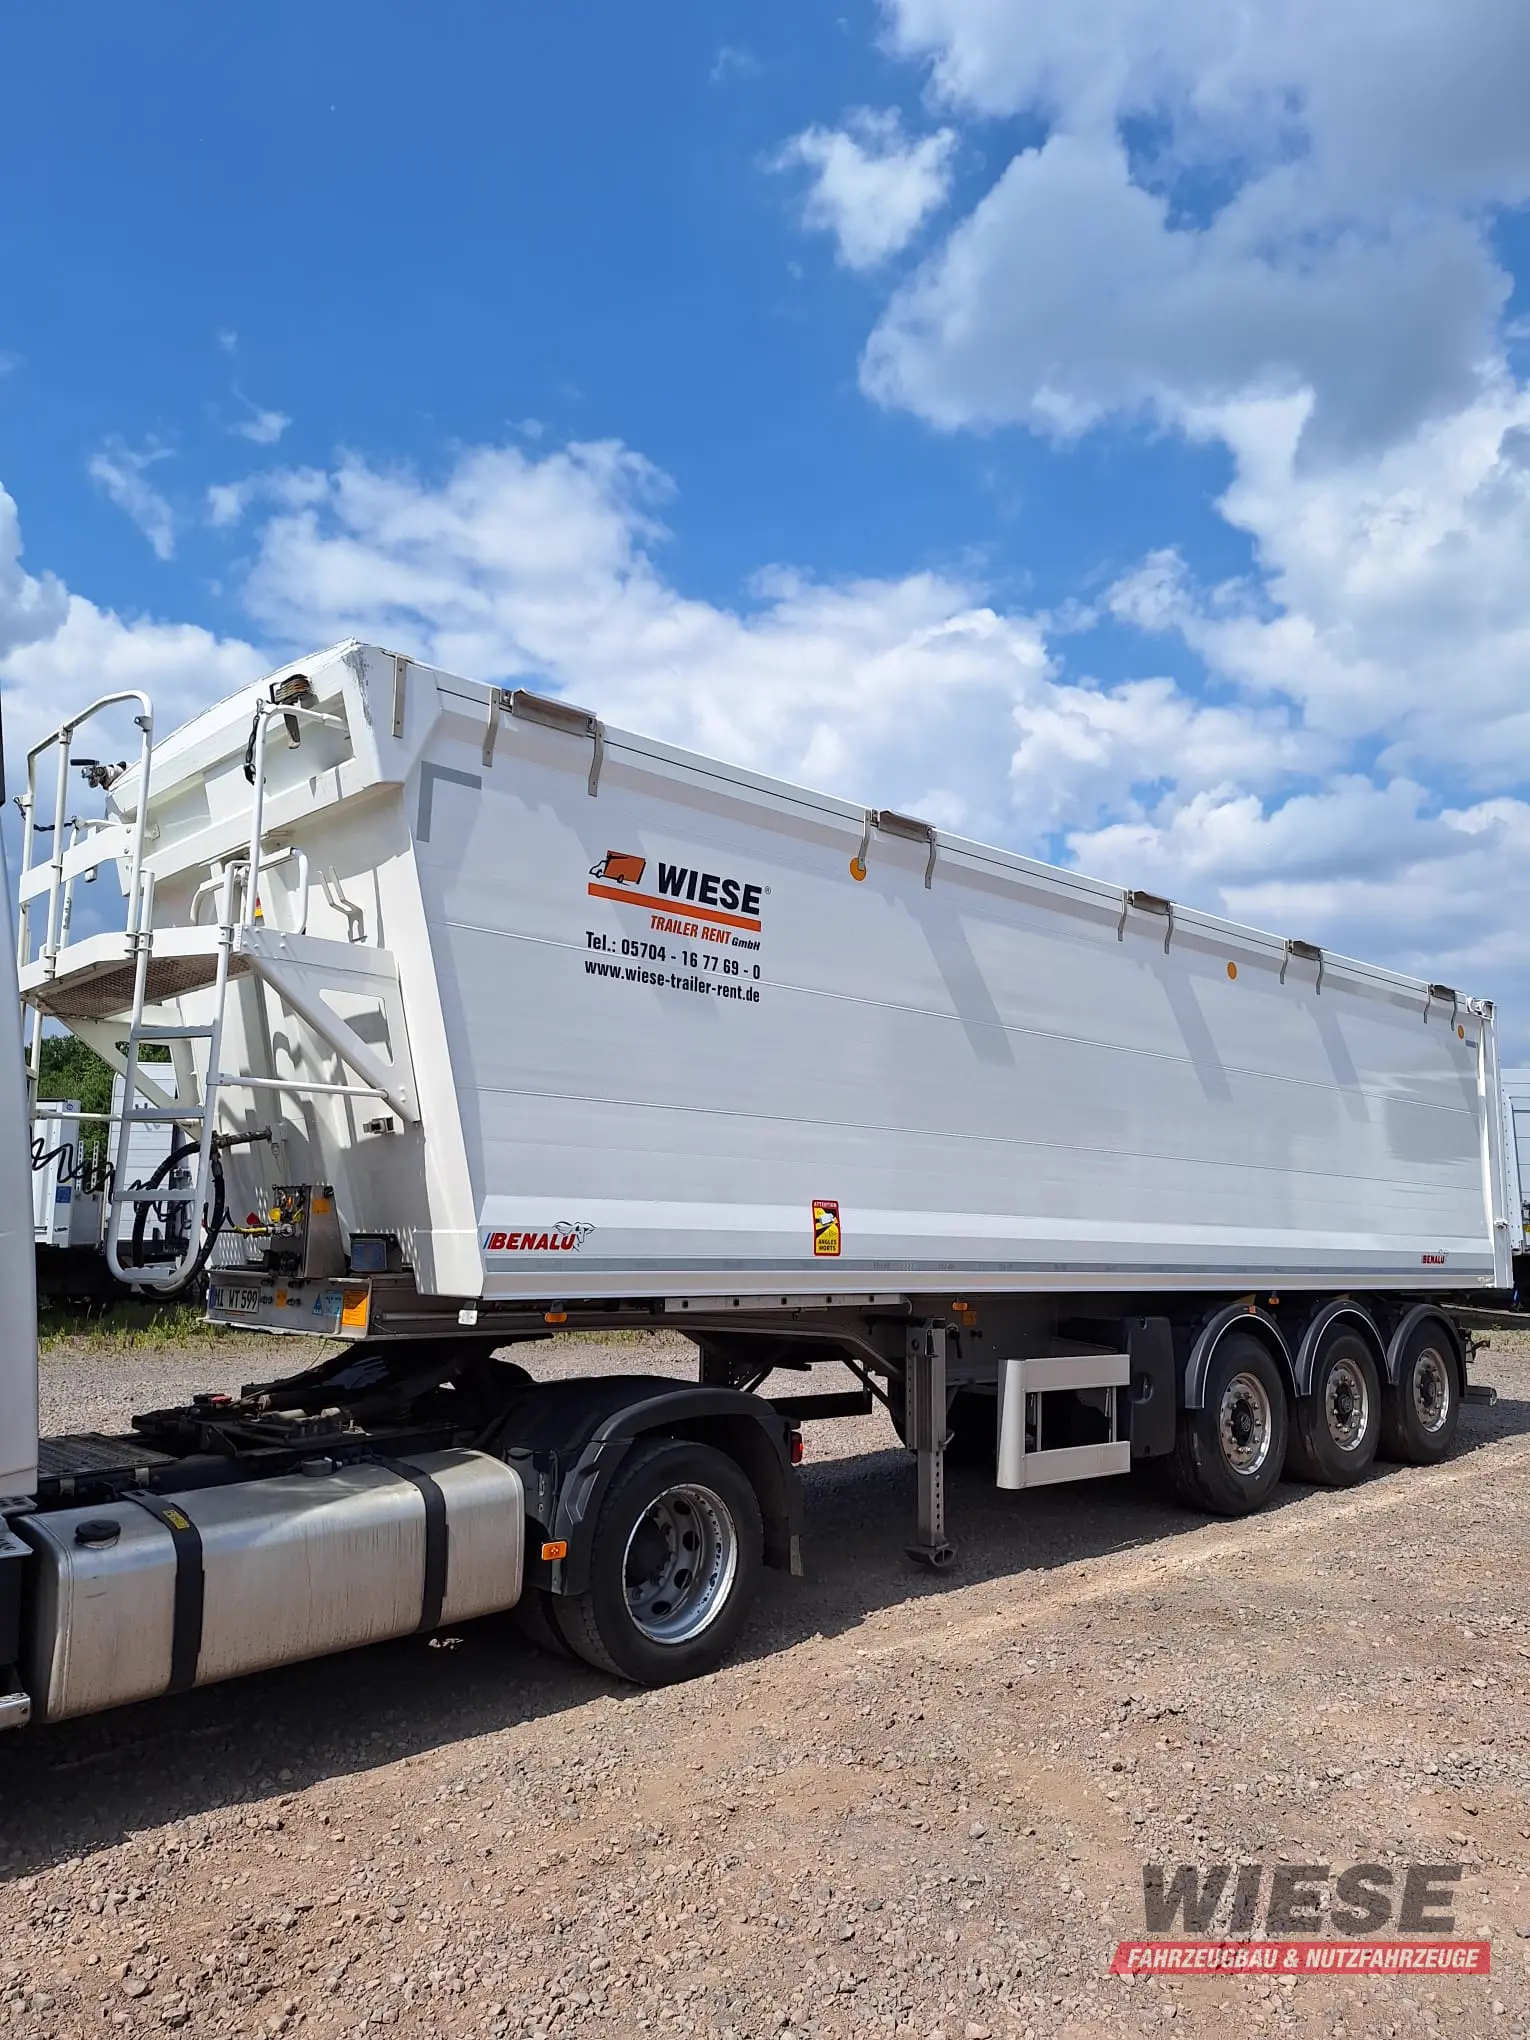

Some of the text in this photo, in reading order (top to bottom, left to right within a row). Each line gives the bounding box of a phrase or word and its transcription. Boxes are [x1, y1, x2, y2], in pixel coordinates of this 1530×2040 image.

[650, 915, 761, 951] TRAILER RENT GmbH
[585, 931, 616, 953] Tel.:
[621, 938, 666, 962] 05704
[682, 950, 698, 968] 16
[703, 954, 719, 972] 77
[723, 958, 739, 976] 69
[753, 964, 761, 980] 0
[585, 960, 760, 1003] www.wiese-trailer-rent.de
[488, 1232, 576, 1250] BENALU
[1422, 1254, 1445, 1264] BENALU
[229, 1288, 240, 1309] WT
[241, 1290, 258, 1310] 599
